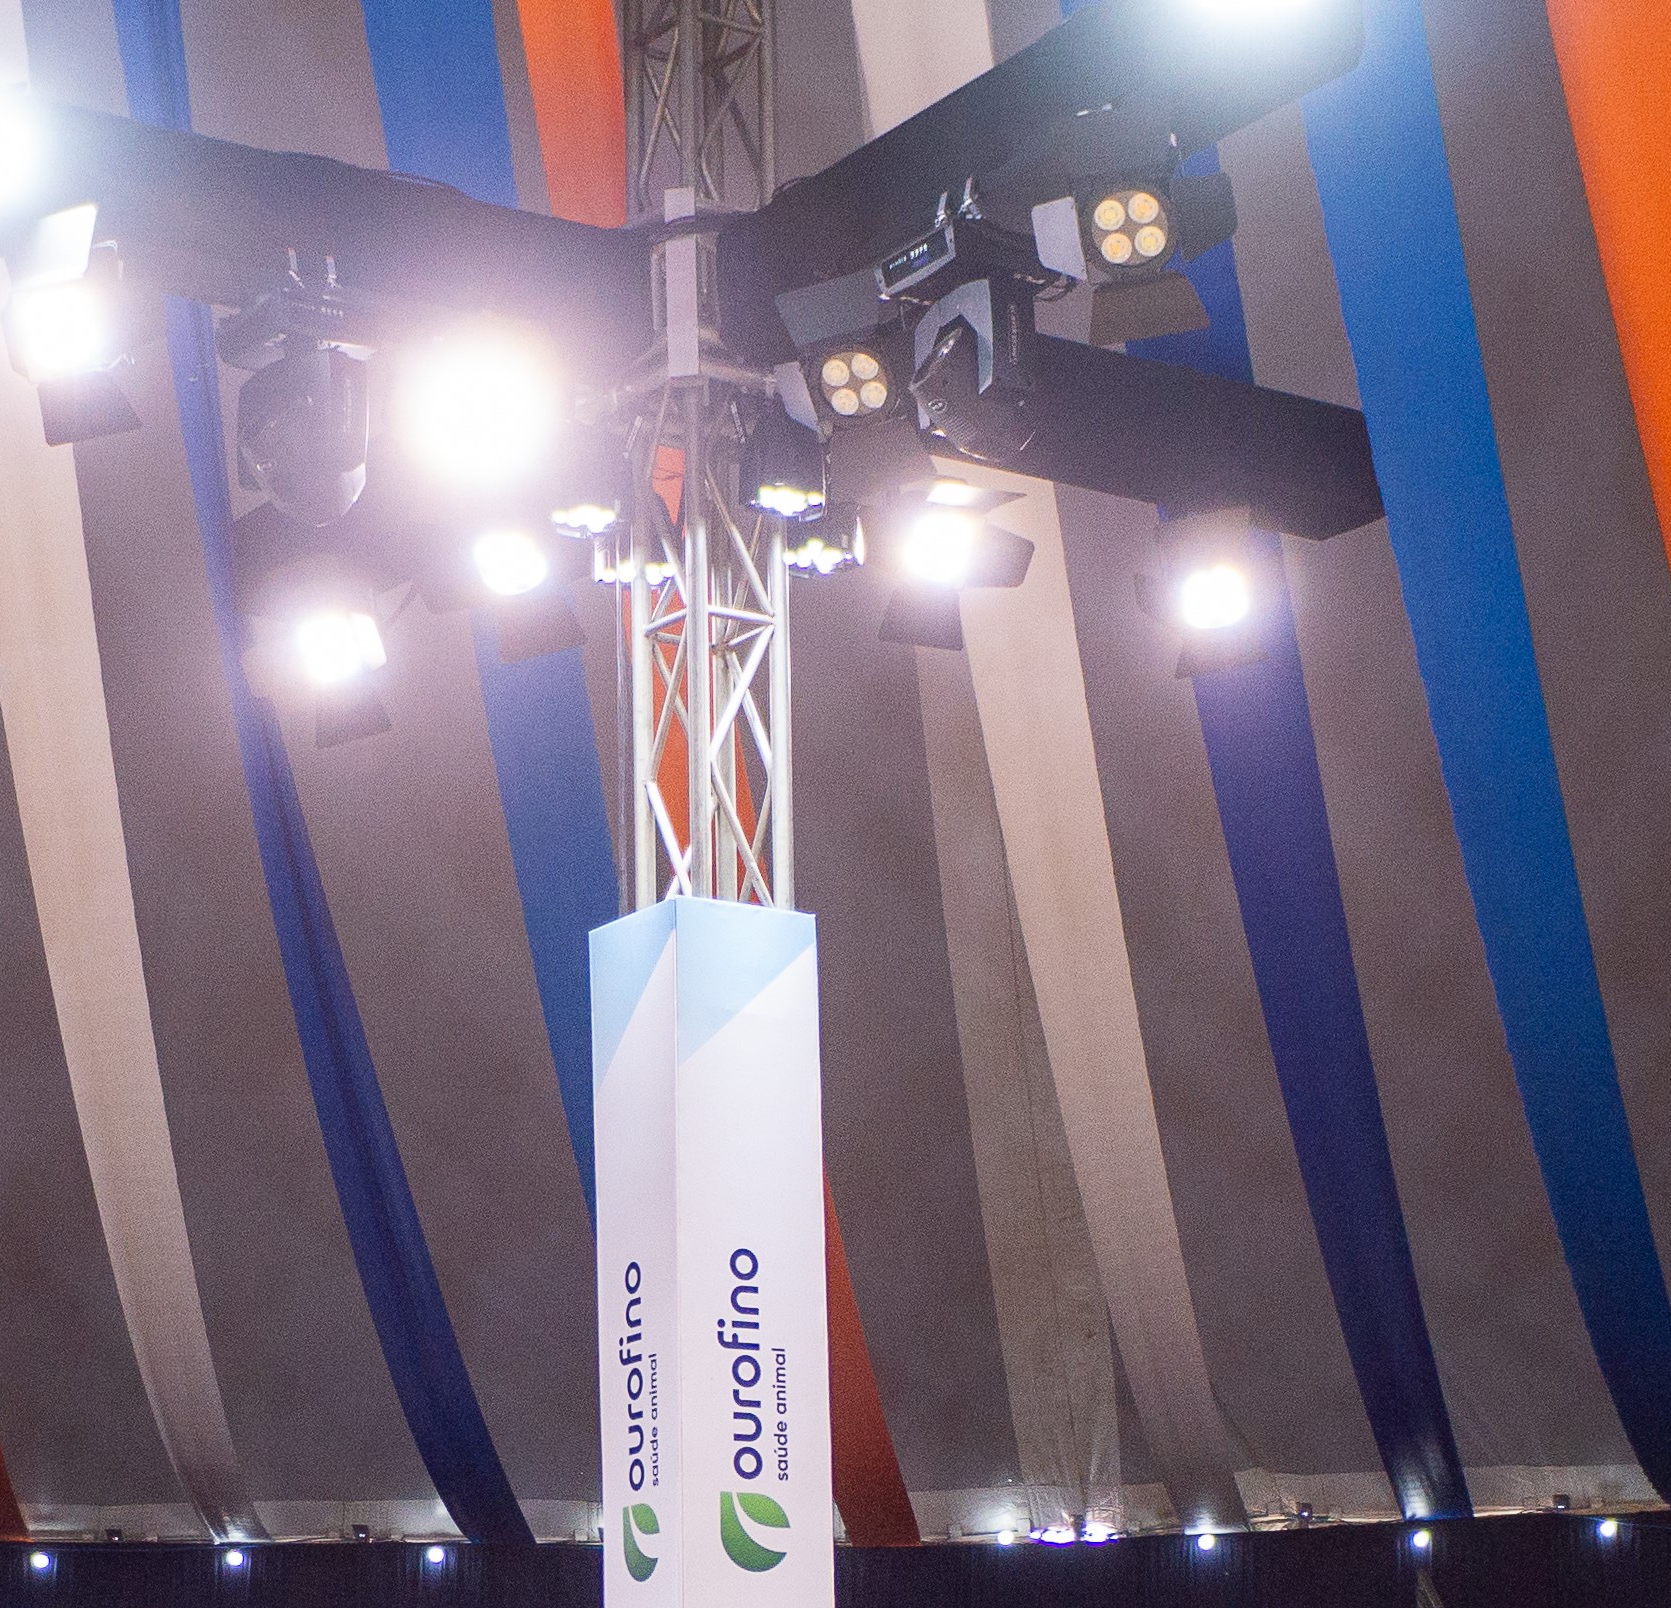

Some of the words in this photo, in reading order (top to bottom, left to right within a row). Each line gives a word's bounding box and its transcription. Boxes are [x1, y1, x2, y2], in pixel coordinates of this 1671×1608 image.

[619, 1260, 646, 1492] ourofino
[648, 1353, 660, 1421] animal
[717, 1248, 763, 1480] ourofino
[771, 1347, 788, 1415] animal
[650, 1426, 661, 1488] saúde
[769, 1419, 789, 1481] saúde
